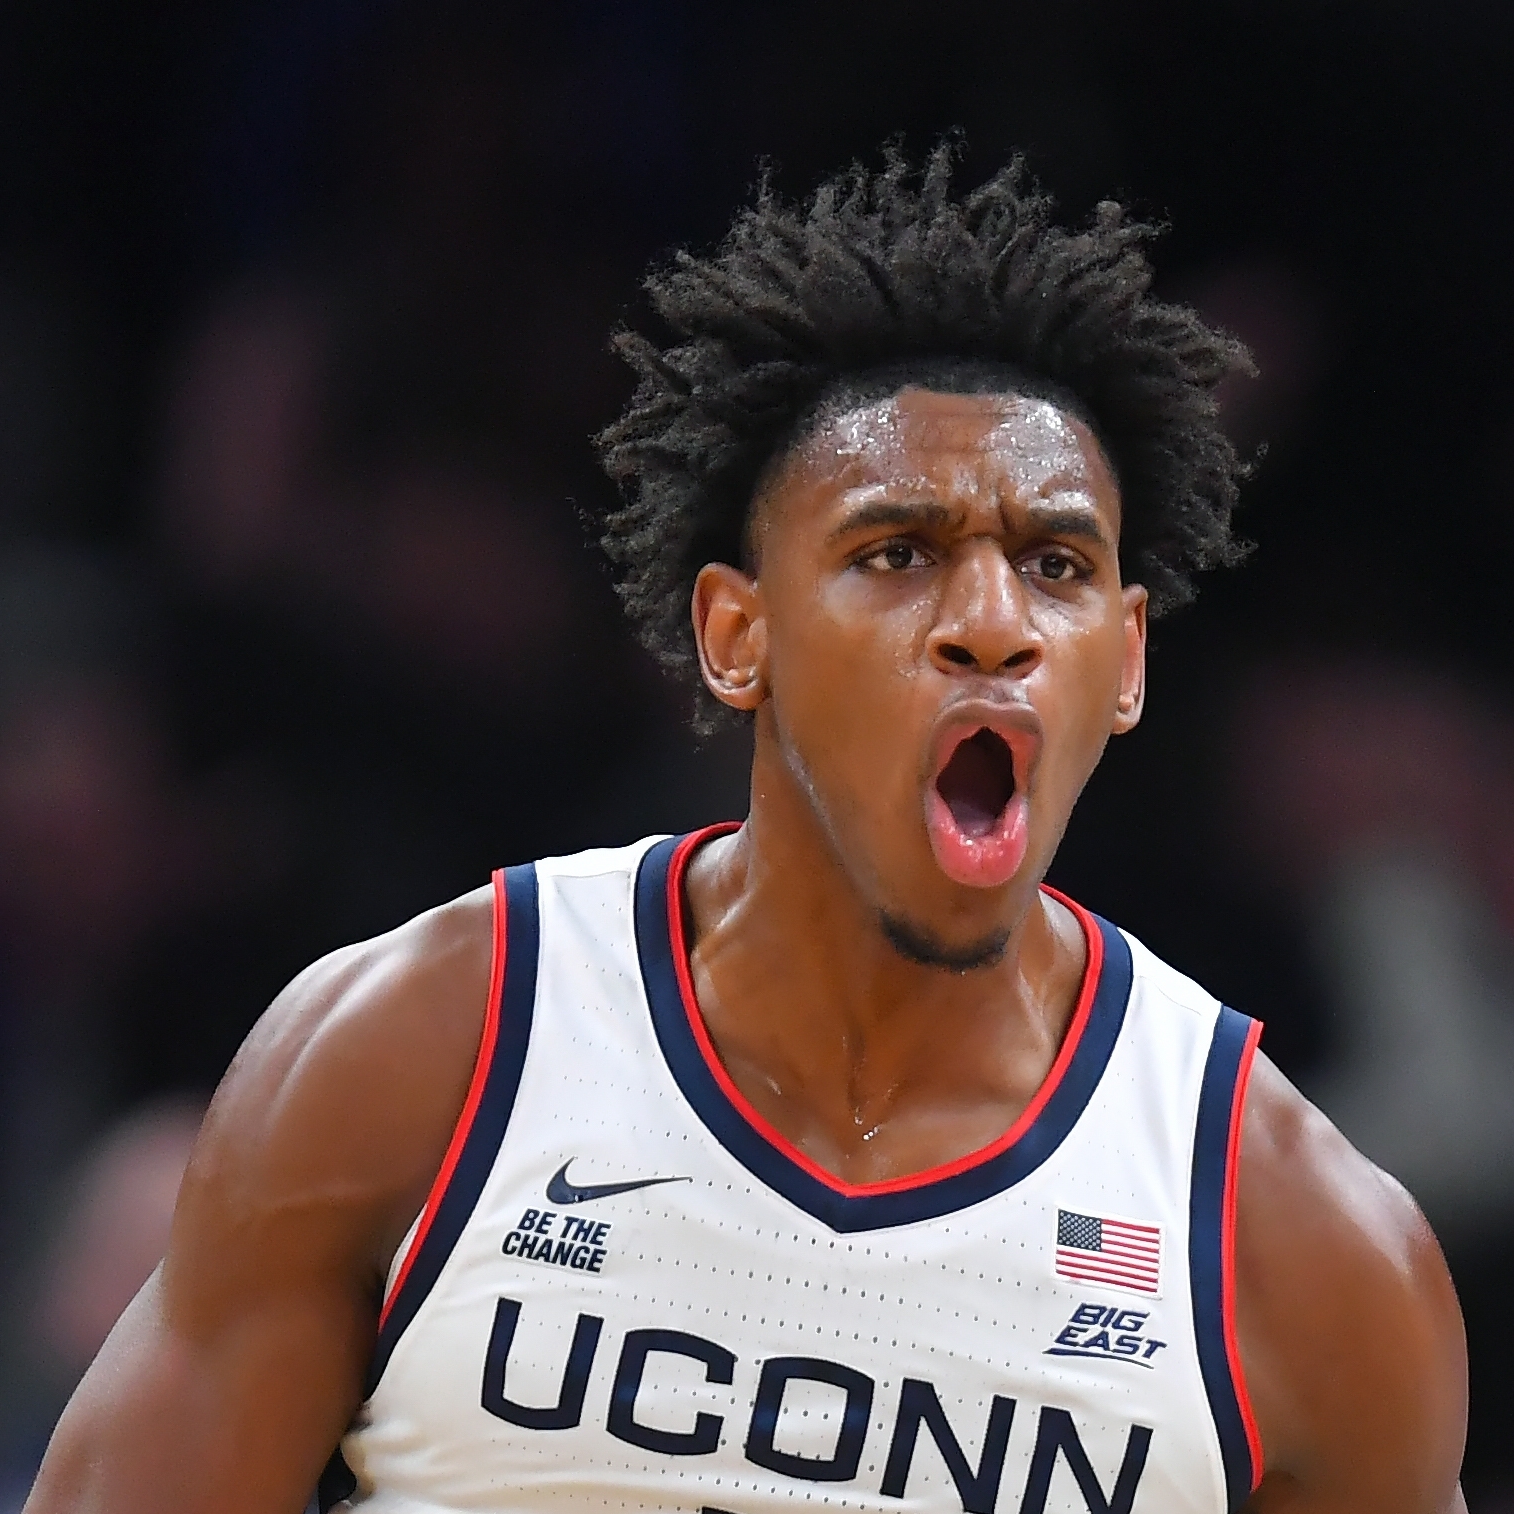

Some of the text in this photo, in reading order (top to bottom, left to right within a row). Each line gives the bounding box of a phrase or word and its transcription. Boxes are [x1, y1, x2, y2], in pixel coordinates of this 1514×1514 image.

[517, 1208, 612, 1246] BE THE
[501, 1230, 608, 1273] CHANGE
[1067, 1302, 1151, 1332] BIG
[1053, 1324, 1168, 1360] EAST
